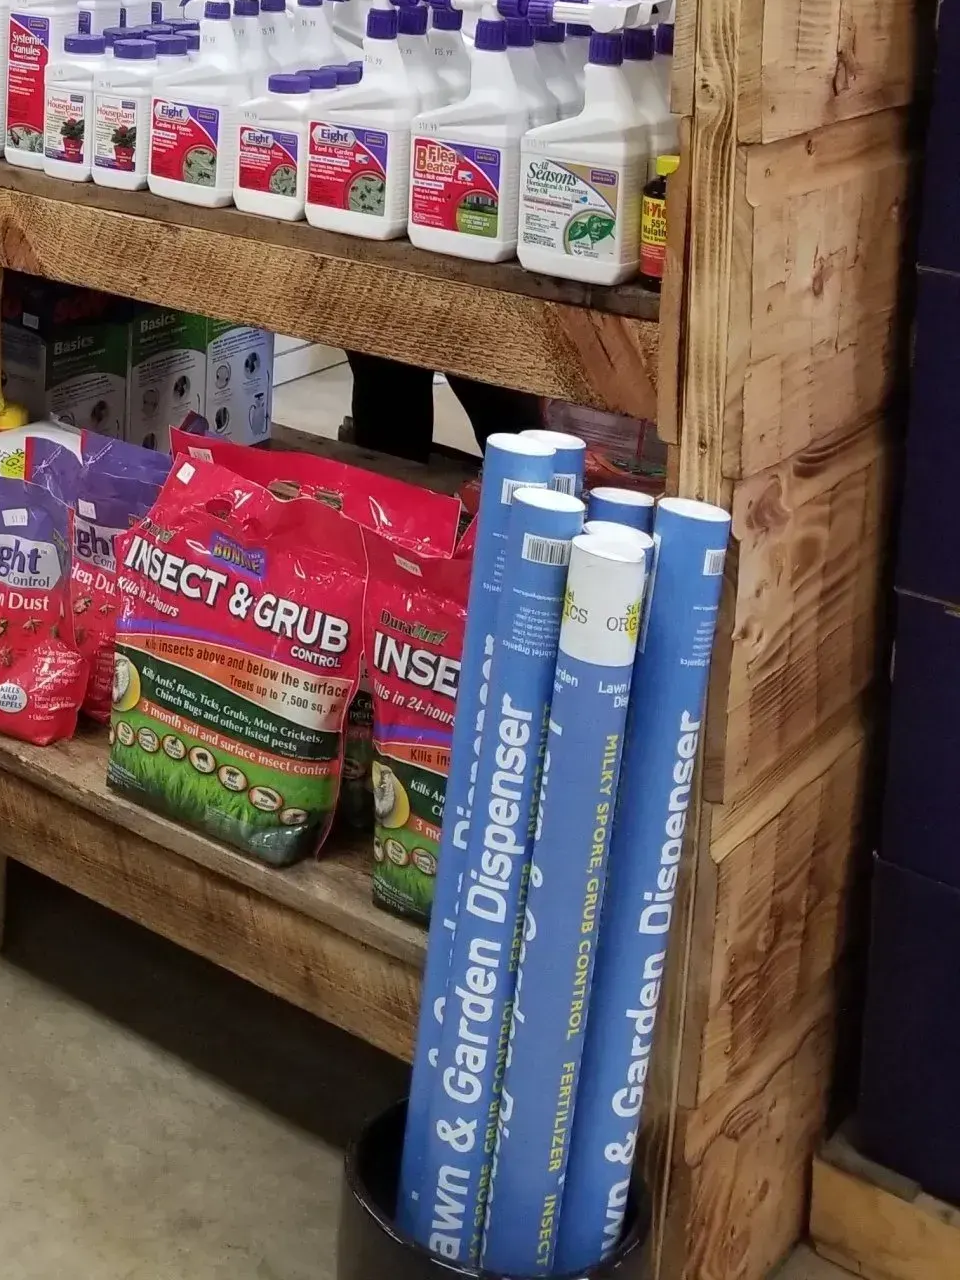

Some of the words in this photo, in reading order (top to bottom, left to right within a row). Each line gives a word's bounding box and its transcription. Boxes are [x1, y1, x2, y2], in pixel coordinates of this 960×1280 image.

[10, 43, 40, 56] Granules
[12, 31, 44, 46] Systemic
[48, 99, 83, 113] Houseplant
[97, 106, 135, 120] Houseplant
[161, 105, 183, 118] Eight
[248, 132, 269, 144] Eight
[321, 128, 348, 143] Eight
[428, 146, 455, 163] Flea
[527, 162, 578, 186] Seasons
[141, 312, 176, 333] Basics
[54, 335, 95, 355] Basics
[8, 572, 50, 588] Control
[8, 592, 49, 611] Dust
[117, 576, 139, 596] Kills
[139, 586, 147, 599] in
[146, 591, 179, 617] 24-hours
[124, 536, 228, 606] INSECT
[228, 582, 254, 620] &
[253, 594, 349, 653] GRUB
[291, 645, 342, 668] CONTROL
[374, 631, 461, 699] INSE
[158, 640, 194, 657] insects
[196, 648, 226, 665] above
[228, 655, 245, 670] and
[247, 659, 278, 681] below
[280, 671, 300, 688] the
[302, 676, 349, 697] surface
[0, 686, 20, 694] KILLS
[229, 674, 254, 693] Treats
[256, 686, 267, 697] up
[269, 689, 278, 699] to
[281, 691, 308, 709] 7,500
[392, 691, 405, 705] in
[598, 681, 627, 694] Lawn
[155, 688, 182, 706] Chinch
[184, 700, 202, 718] Bugs
[204, 709, 219, 722] and
[220, 716, 243, 733] other
[244, 726, 269, 743] listed
[271, 738, 297, 752] pests
[176, 683, 198, 702] Fleas,
[200, 693, 221, 712] Ticks,
[222, 705, 252, 724] Grubs,
[254, 717, 277, 733] Mole
[280, 725, 324, 744] Crickets,
[143, 701, 149, 712] 3
[150, 706, 182, 729] month
[183, 723, 199, 738] soil
[200, 729, 218, 746] and
[220, 738, 256, 762] surface
[258, 750, 291, 774] insect
[411, 748, 432, 763] Kills
[599, 733, 618, 797] MILKY
[411, 779, 430, 797] Kills
[466, 692, 532, 923] Dispenser
[416, 819, 422, 831] 3
[581, 878, 600, 934] GRUB
[612, 951, 666, 1118] Garden
[639, 710, 701, 935] Dispenser
[566, 941, 590, 1041] CONTROL
[443, 937, 502, 1104] Garden
[548, 1061, 576, 1172] FERTILIZER
[436, 1119, 478, 1152] &
[430, 1165, 470, 1259] awn
[536, 1194, 556, 1267] INSECT
